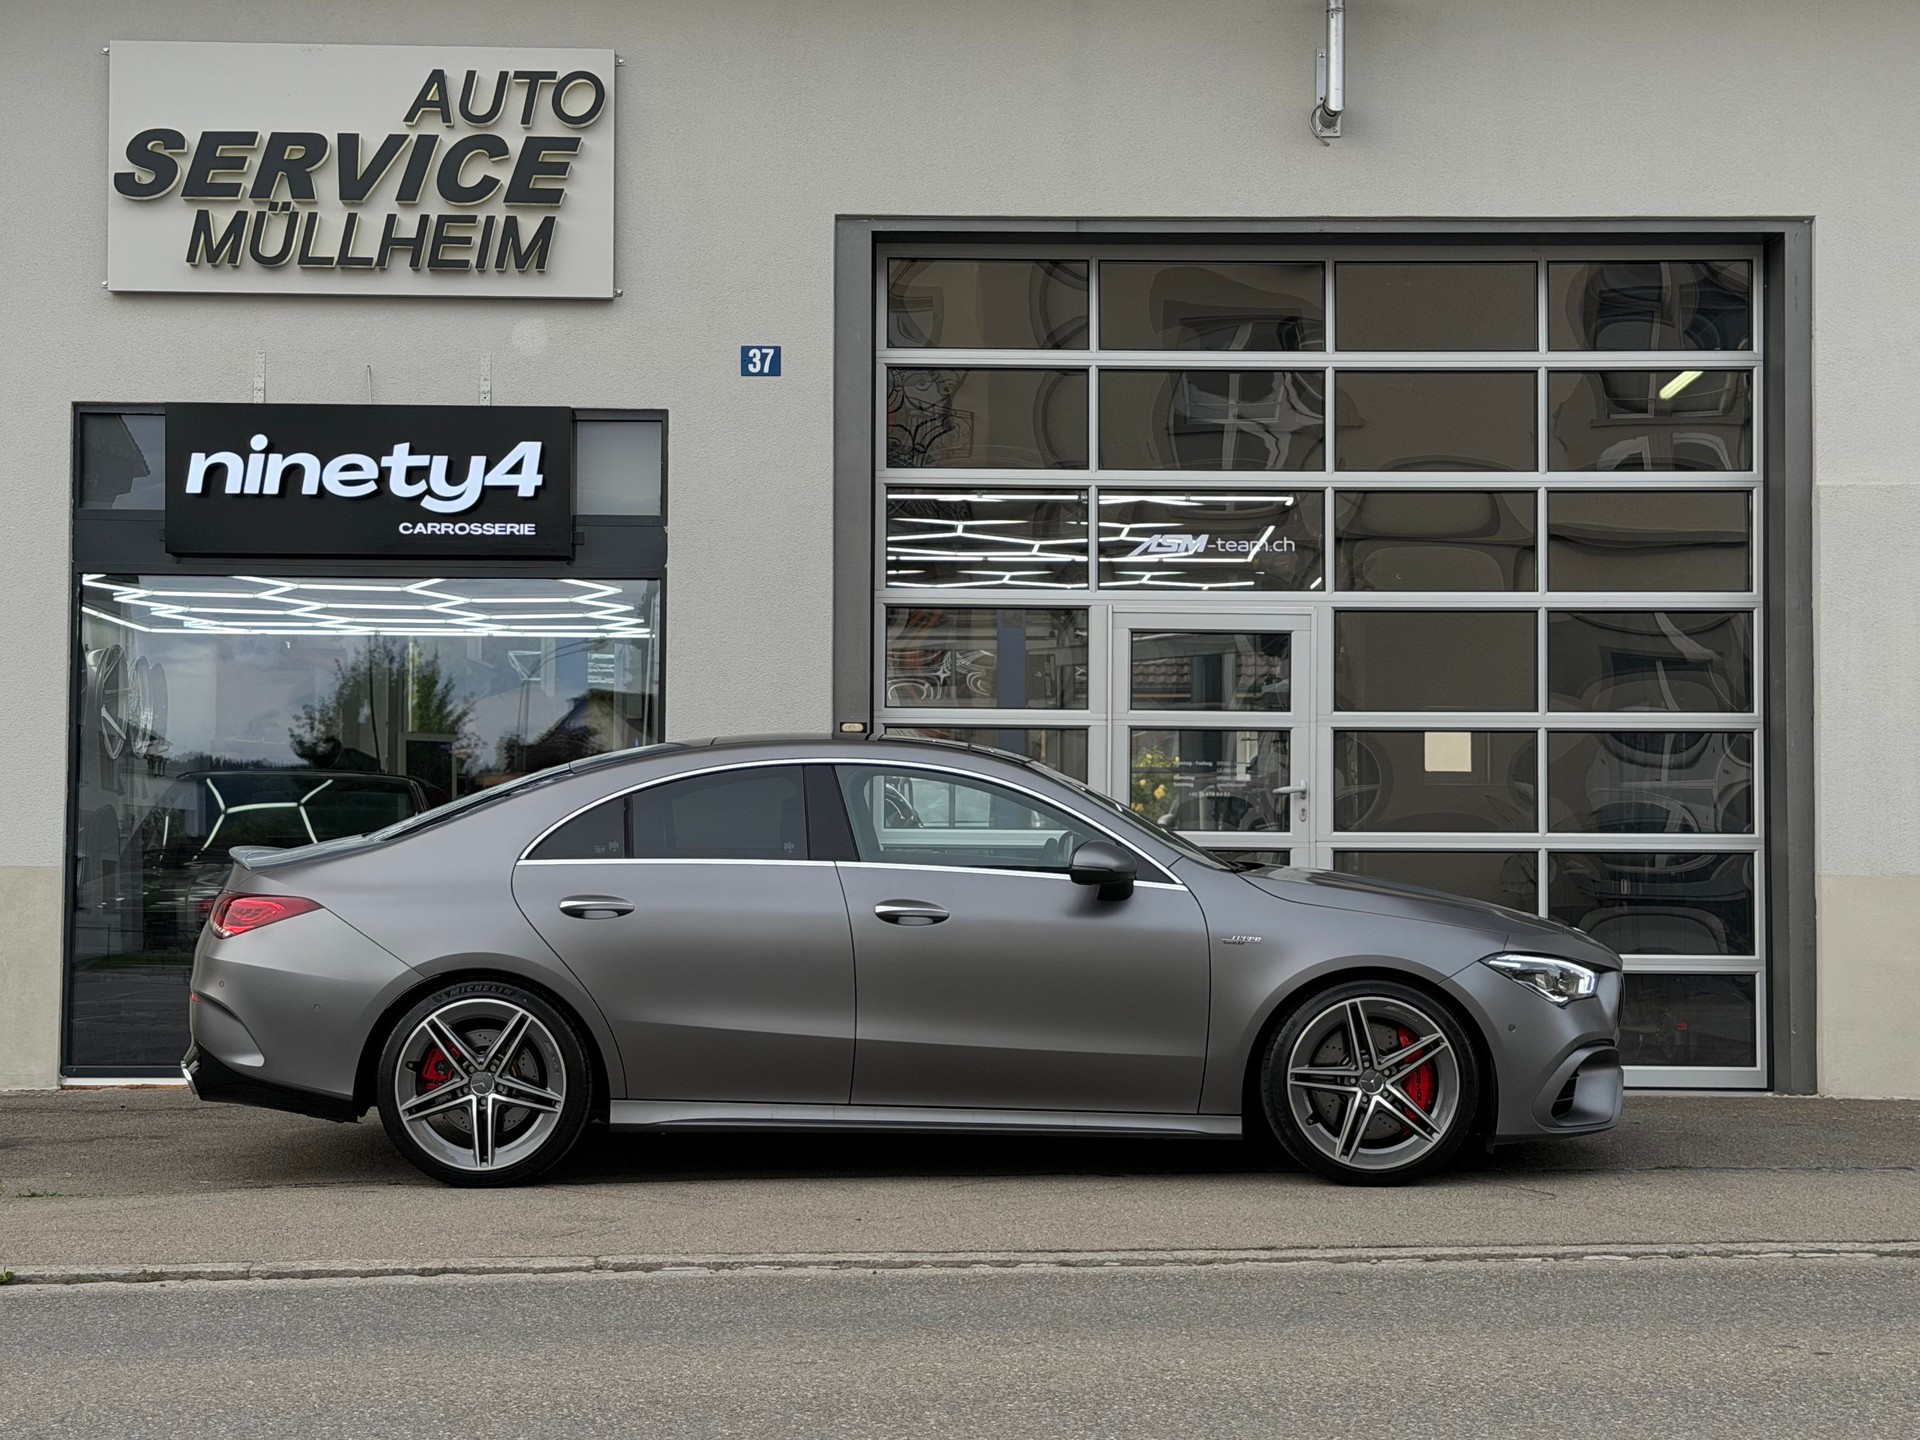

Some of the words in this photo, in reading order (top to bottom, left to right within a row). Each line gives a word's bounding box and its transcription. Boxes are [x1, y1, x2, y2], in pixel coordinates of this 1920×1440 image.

[403, 68, 606, 128] AUTO
[113, 127, 583, 206] SERVICE
[185, 201, 558, 272] MÜLLHEIM
[748, 348, 775, 373] 37
[185, 433, 543, 514] ninety4
[398, 522, 537, 536] CARROSSERIE
[450, 984, 513, 996] MICHELIN
